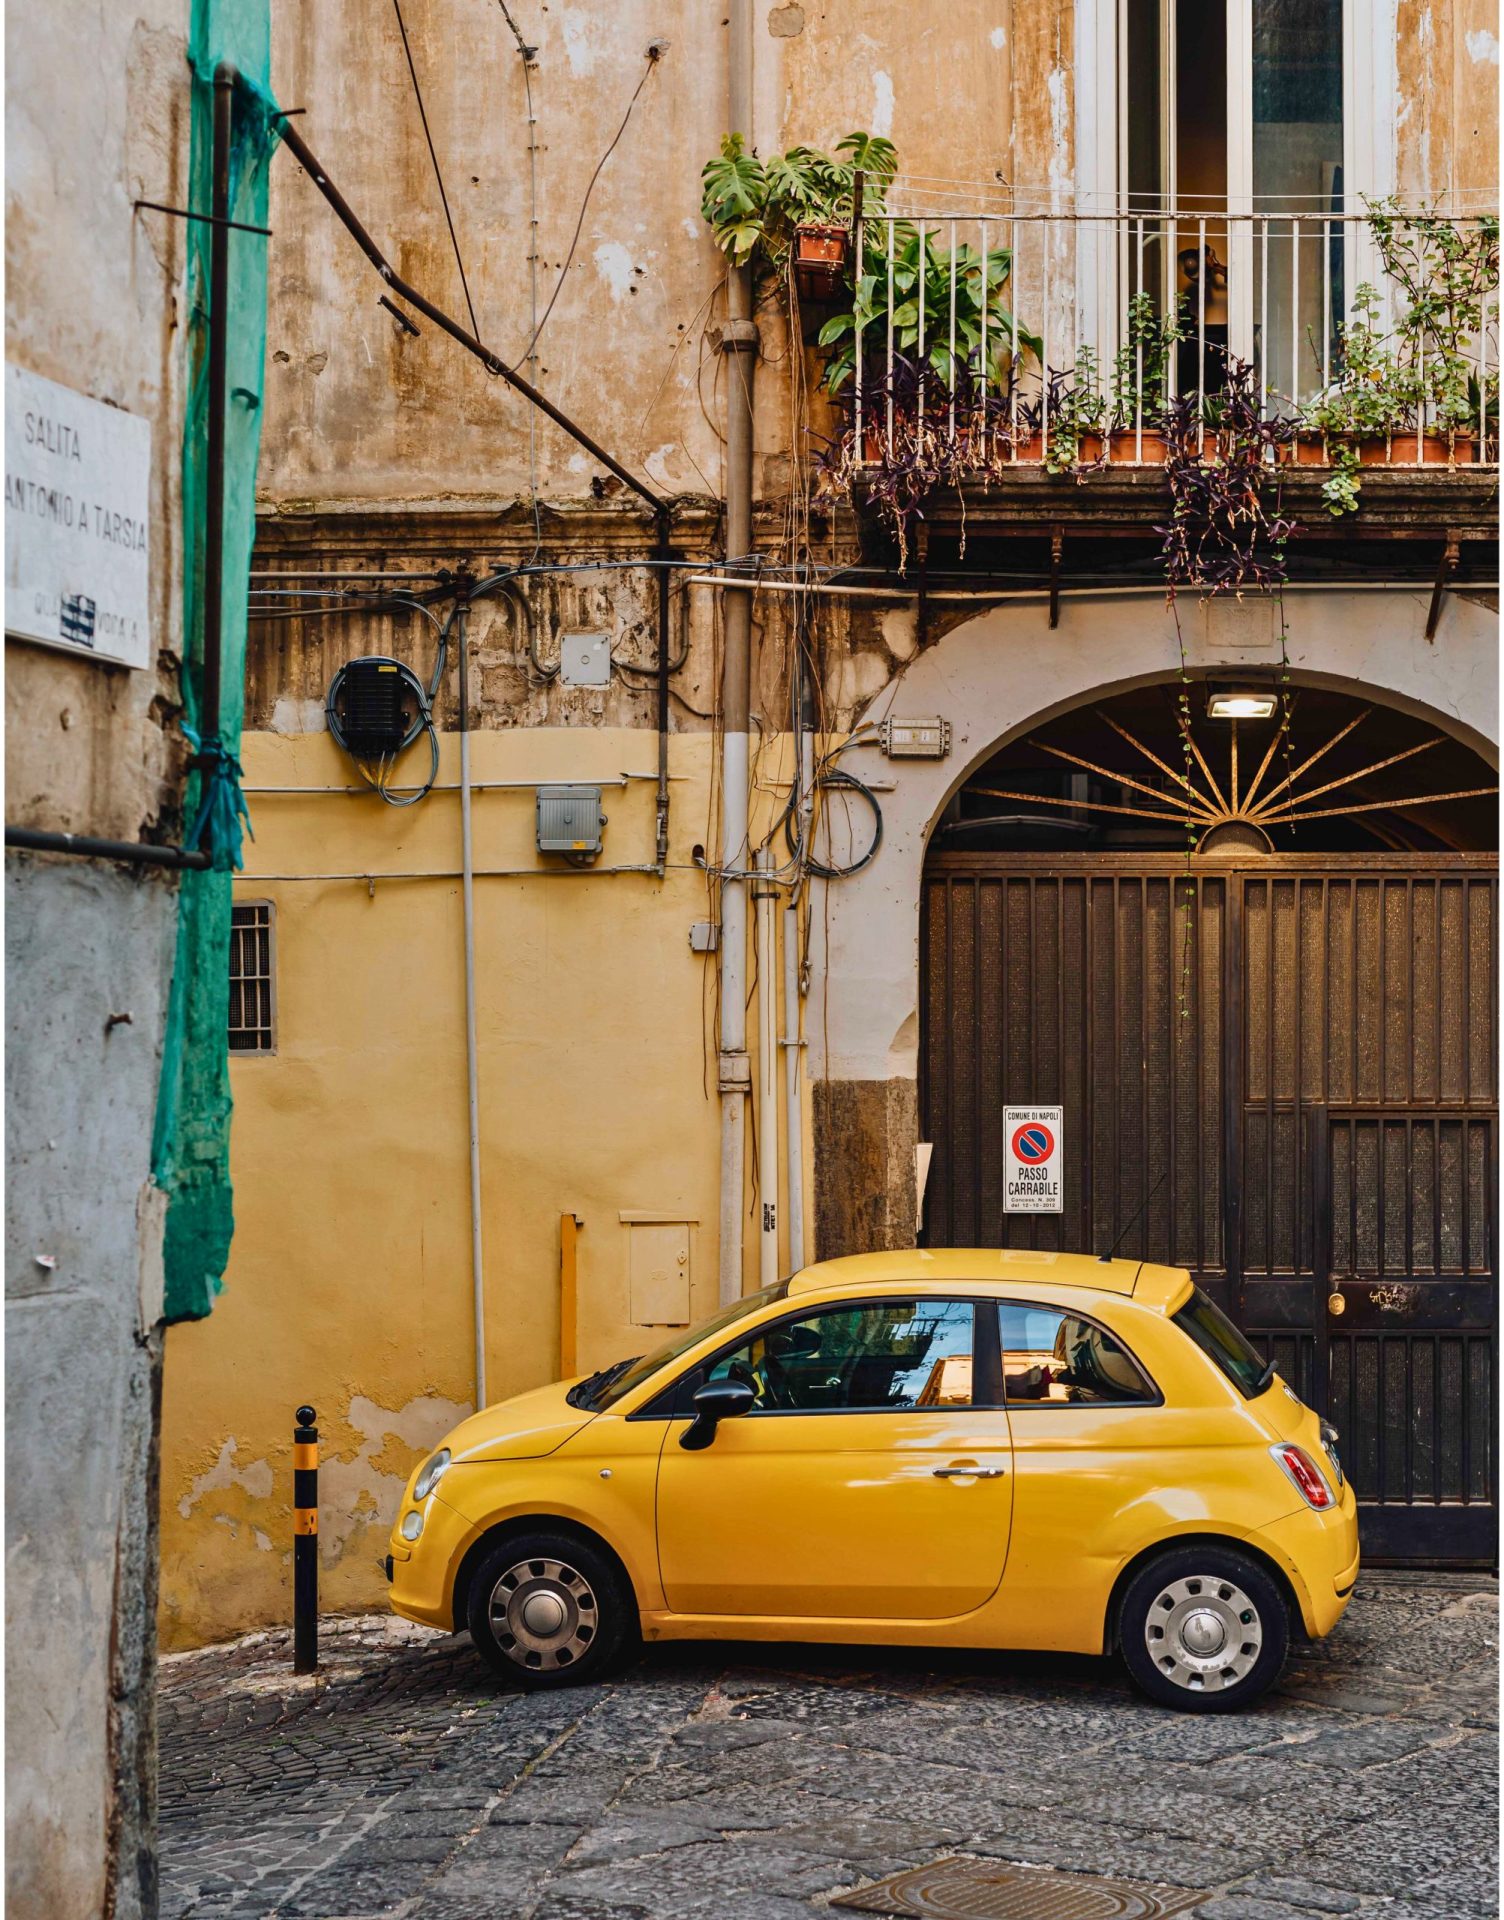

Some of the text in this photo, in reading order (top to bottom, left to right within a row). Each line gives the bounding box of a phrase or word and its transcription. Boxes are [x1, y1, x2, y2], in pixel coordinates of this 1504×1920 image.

[25, 411, 81, 463] SALITA
[78, 501, 88, 534] A
[94, 505, 146, 552] TARSIA
[1008, 1112, 1059, 1120] COMUNE DI NAPOLI
[1018, 1167, 1048, 1180] PASSO
[1008, 1182, 1058, 1195] CARRABILE
